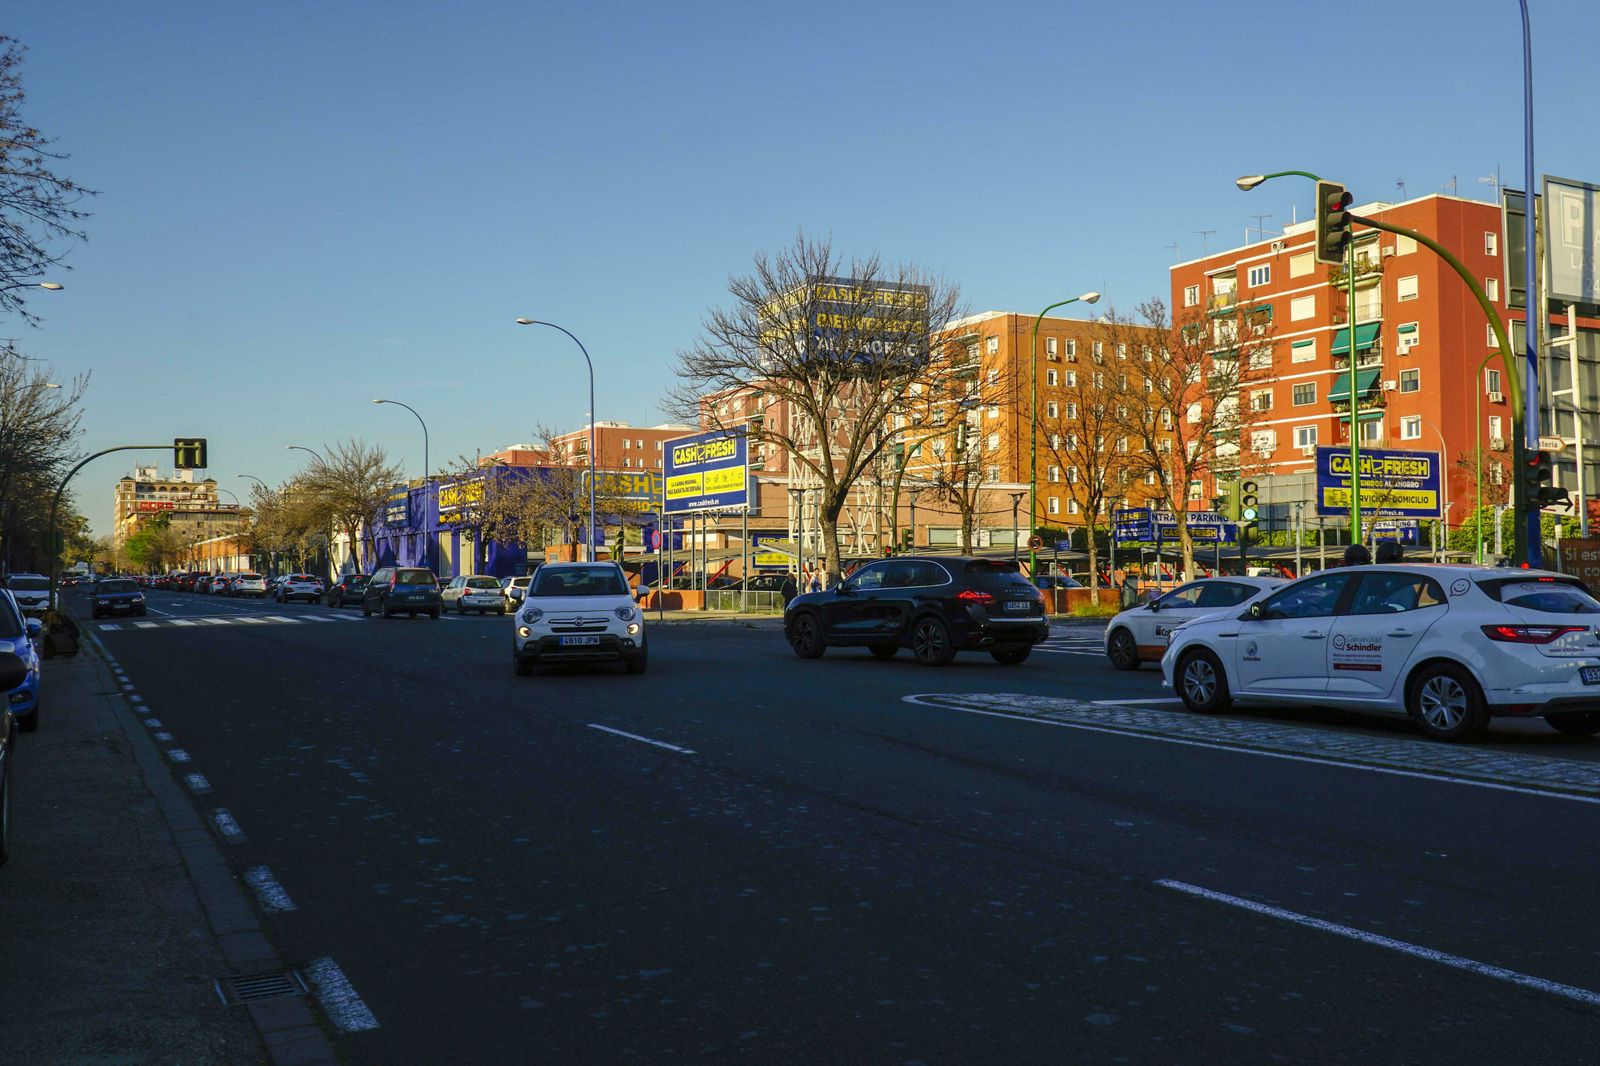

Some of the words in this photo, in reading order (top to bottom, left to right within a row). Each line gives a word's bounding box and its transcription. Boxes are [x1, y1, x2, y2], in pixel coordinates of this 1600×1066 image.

[674, 446, 697, 464] CASH
[705, 438, 735, 460] FRESH
[1332, 457, 1371, 474] CAH
[1384, 460, 1428, 475] FRESH
[1392, 496, 1429, 504] DOMICILIO
[1190, 513, 1229, 522] PARKING
[564, 636, 583, 644] 4910
[1346, 643, 1382, 652] Schindler
